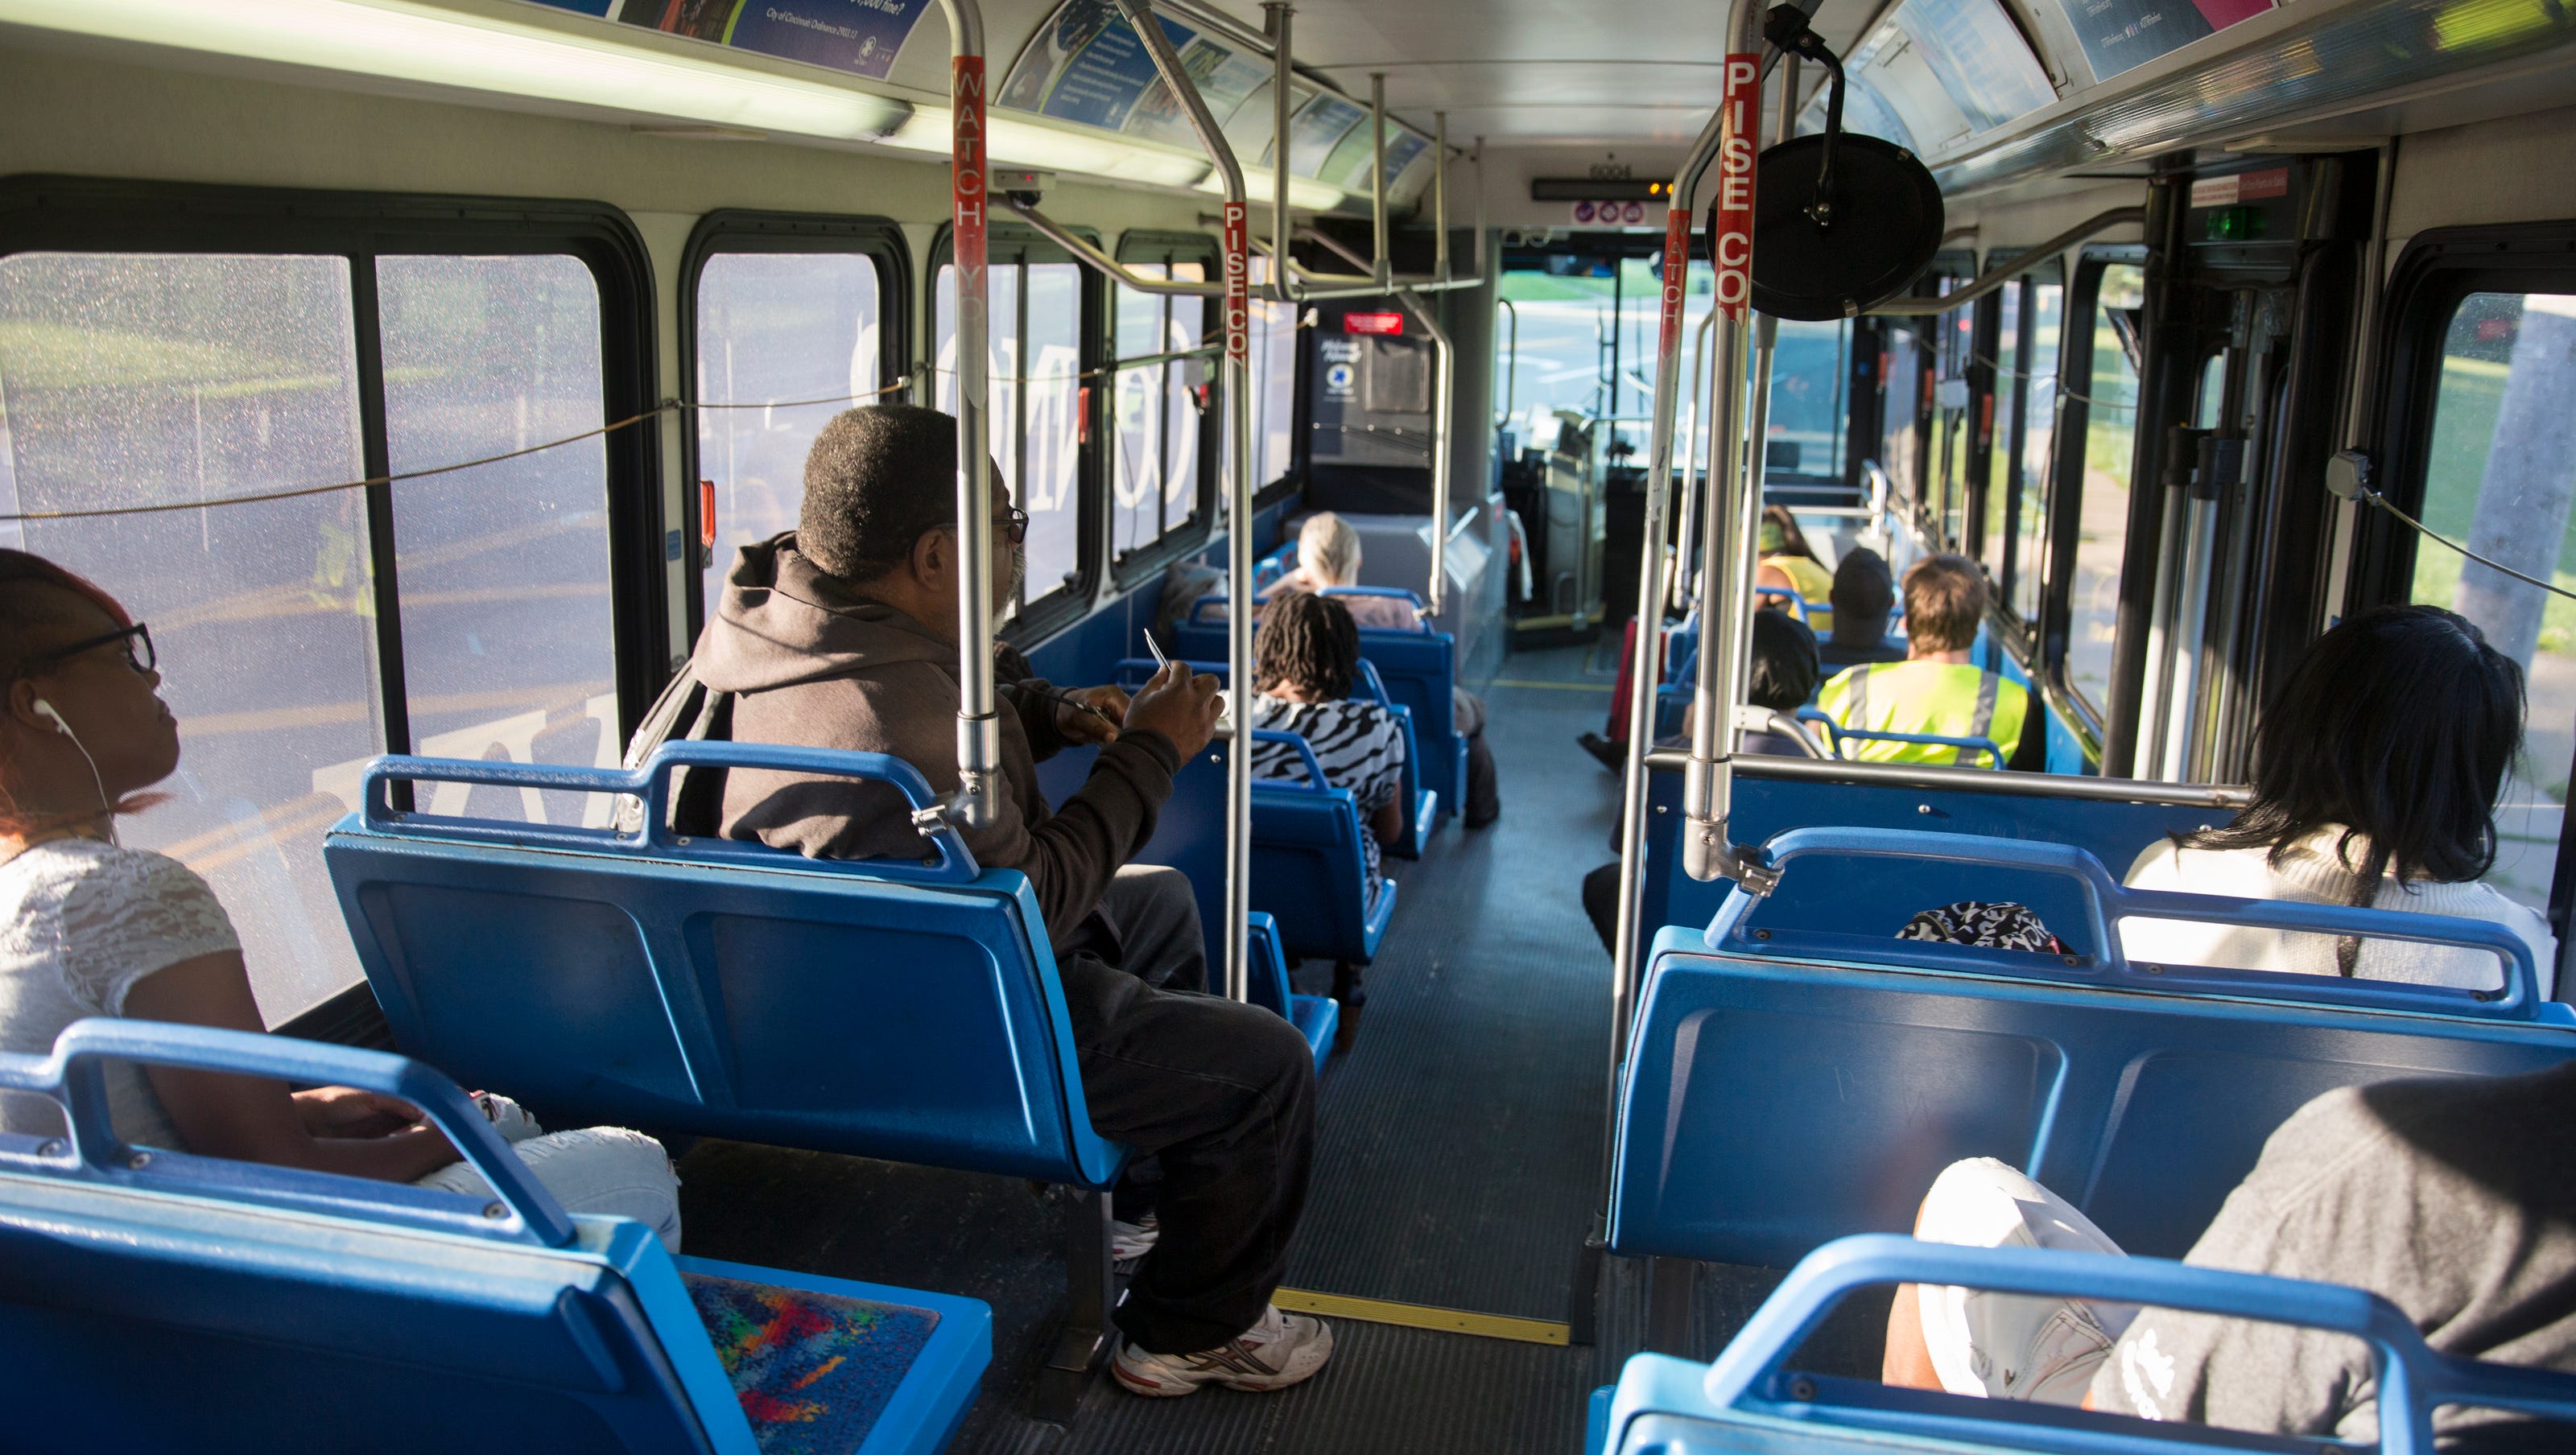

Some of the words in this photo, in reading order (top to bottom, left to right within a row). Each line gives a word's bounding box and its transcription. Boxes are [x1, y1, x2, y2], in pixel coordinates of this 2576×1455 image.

[955, 72, 984, 226] WATCH
[1722, 61, 1756, 211] PISE
[1226, 206, 1245, 297] PISE
[1662, 219, 1690, 325] WATCH
